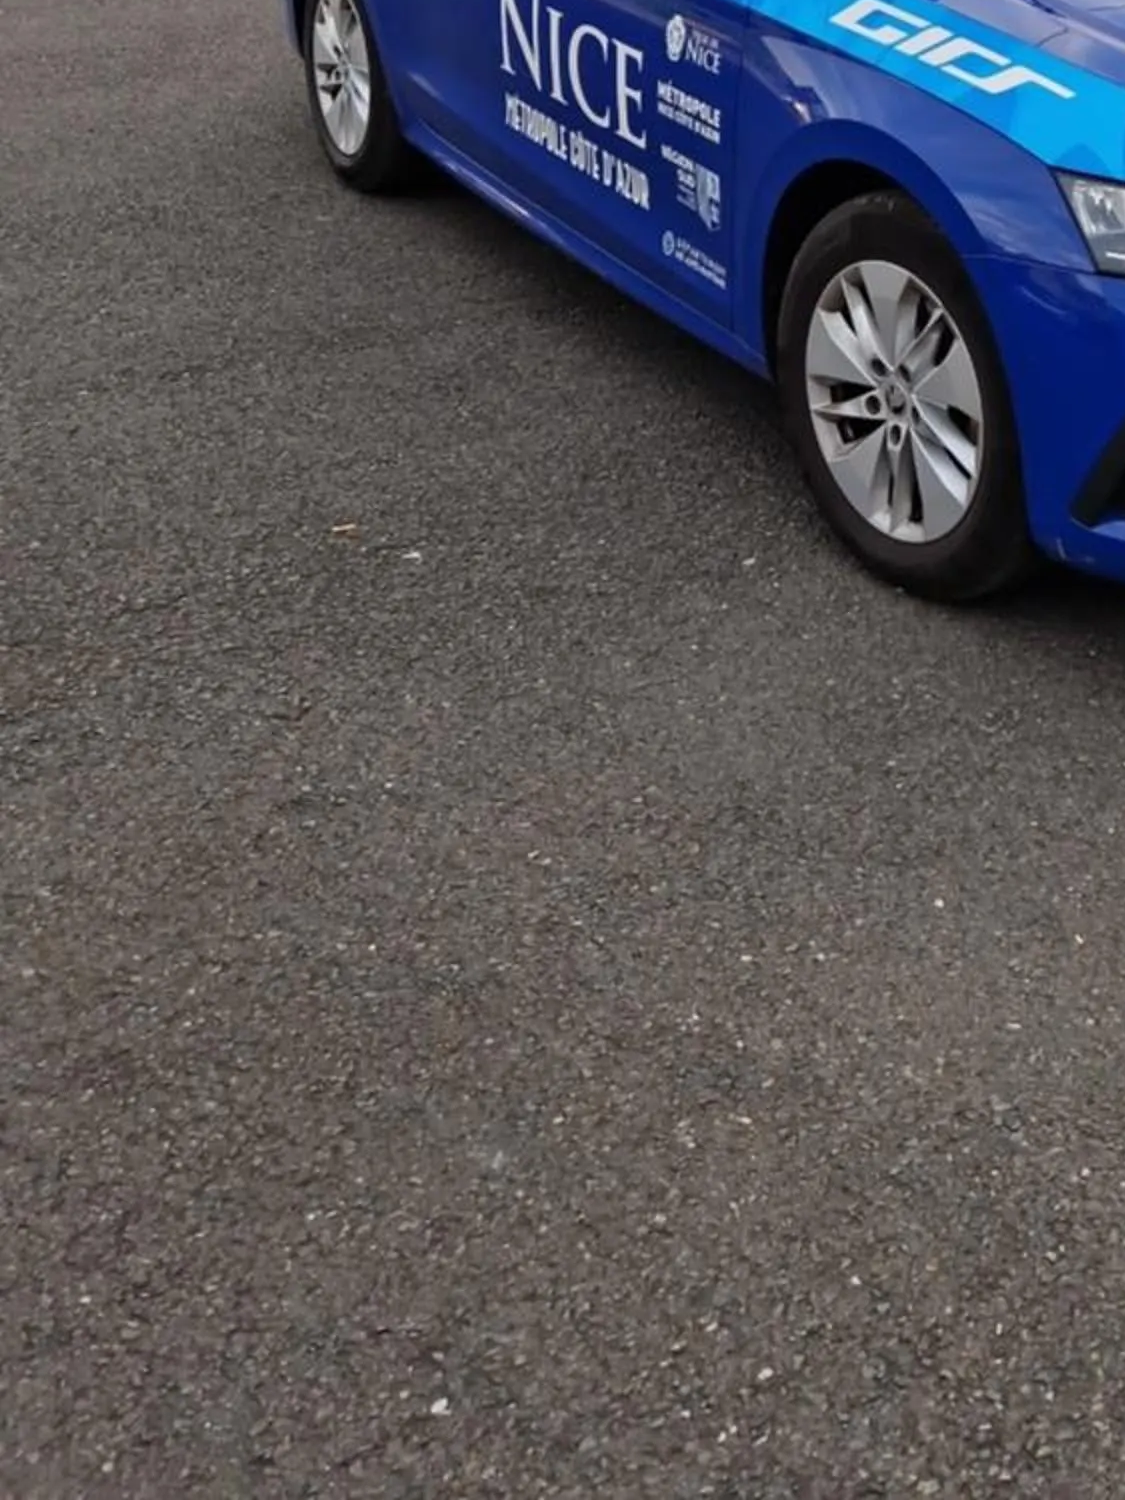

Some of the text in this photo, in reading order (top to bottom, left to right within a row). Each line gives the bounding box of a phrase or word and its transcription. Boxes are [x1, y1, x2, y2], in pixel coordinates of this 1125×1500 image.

[685, 38, 720, 74] NICE
[505, 91, 567, 161] MÉTROPOLE
[570, 131, 599, 180] CÔTE
[602, 149, 649, 210] D'AZUR
